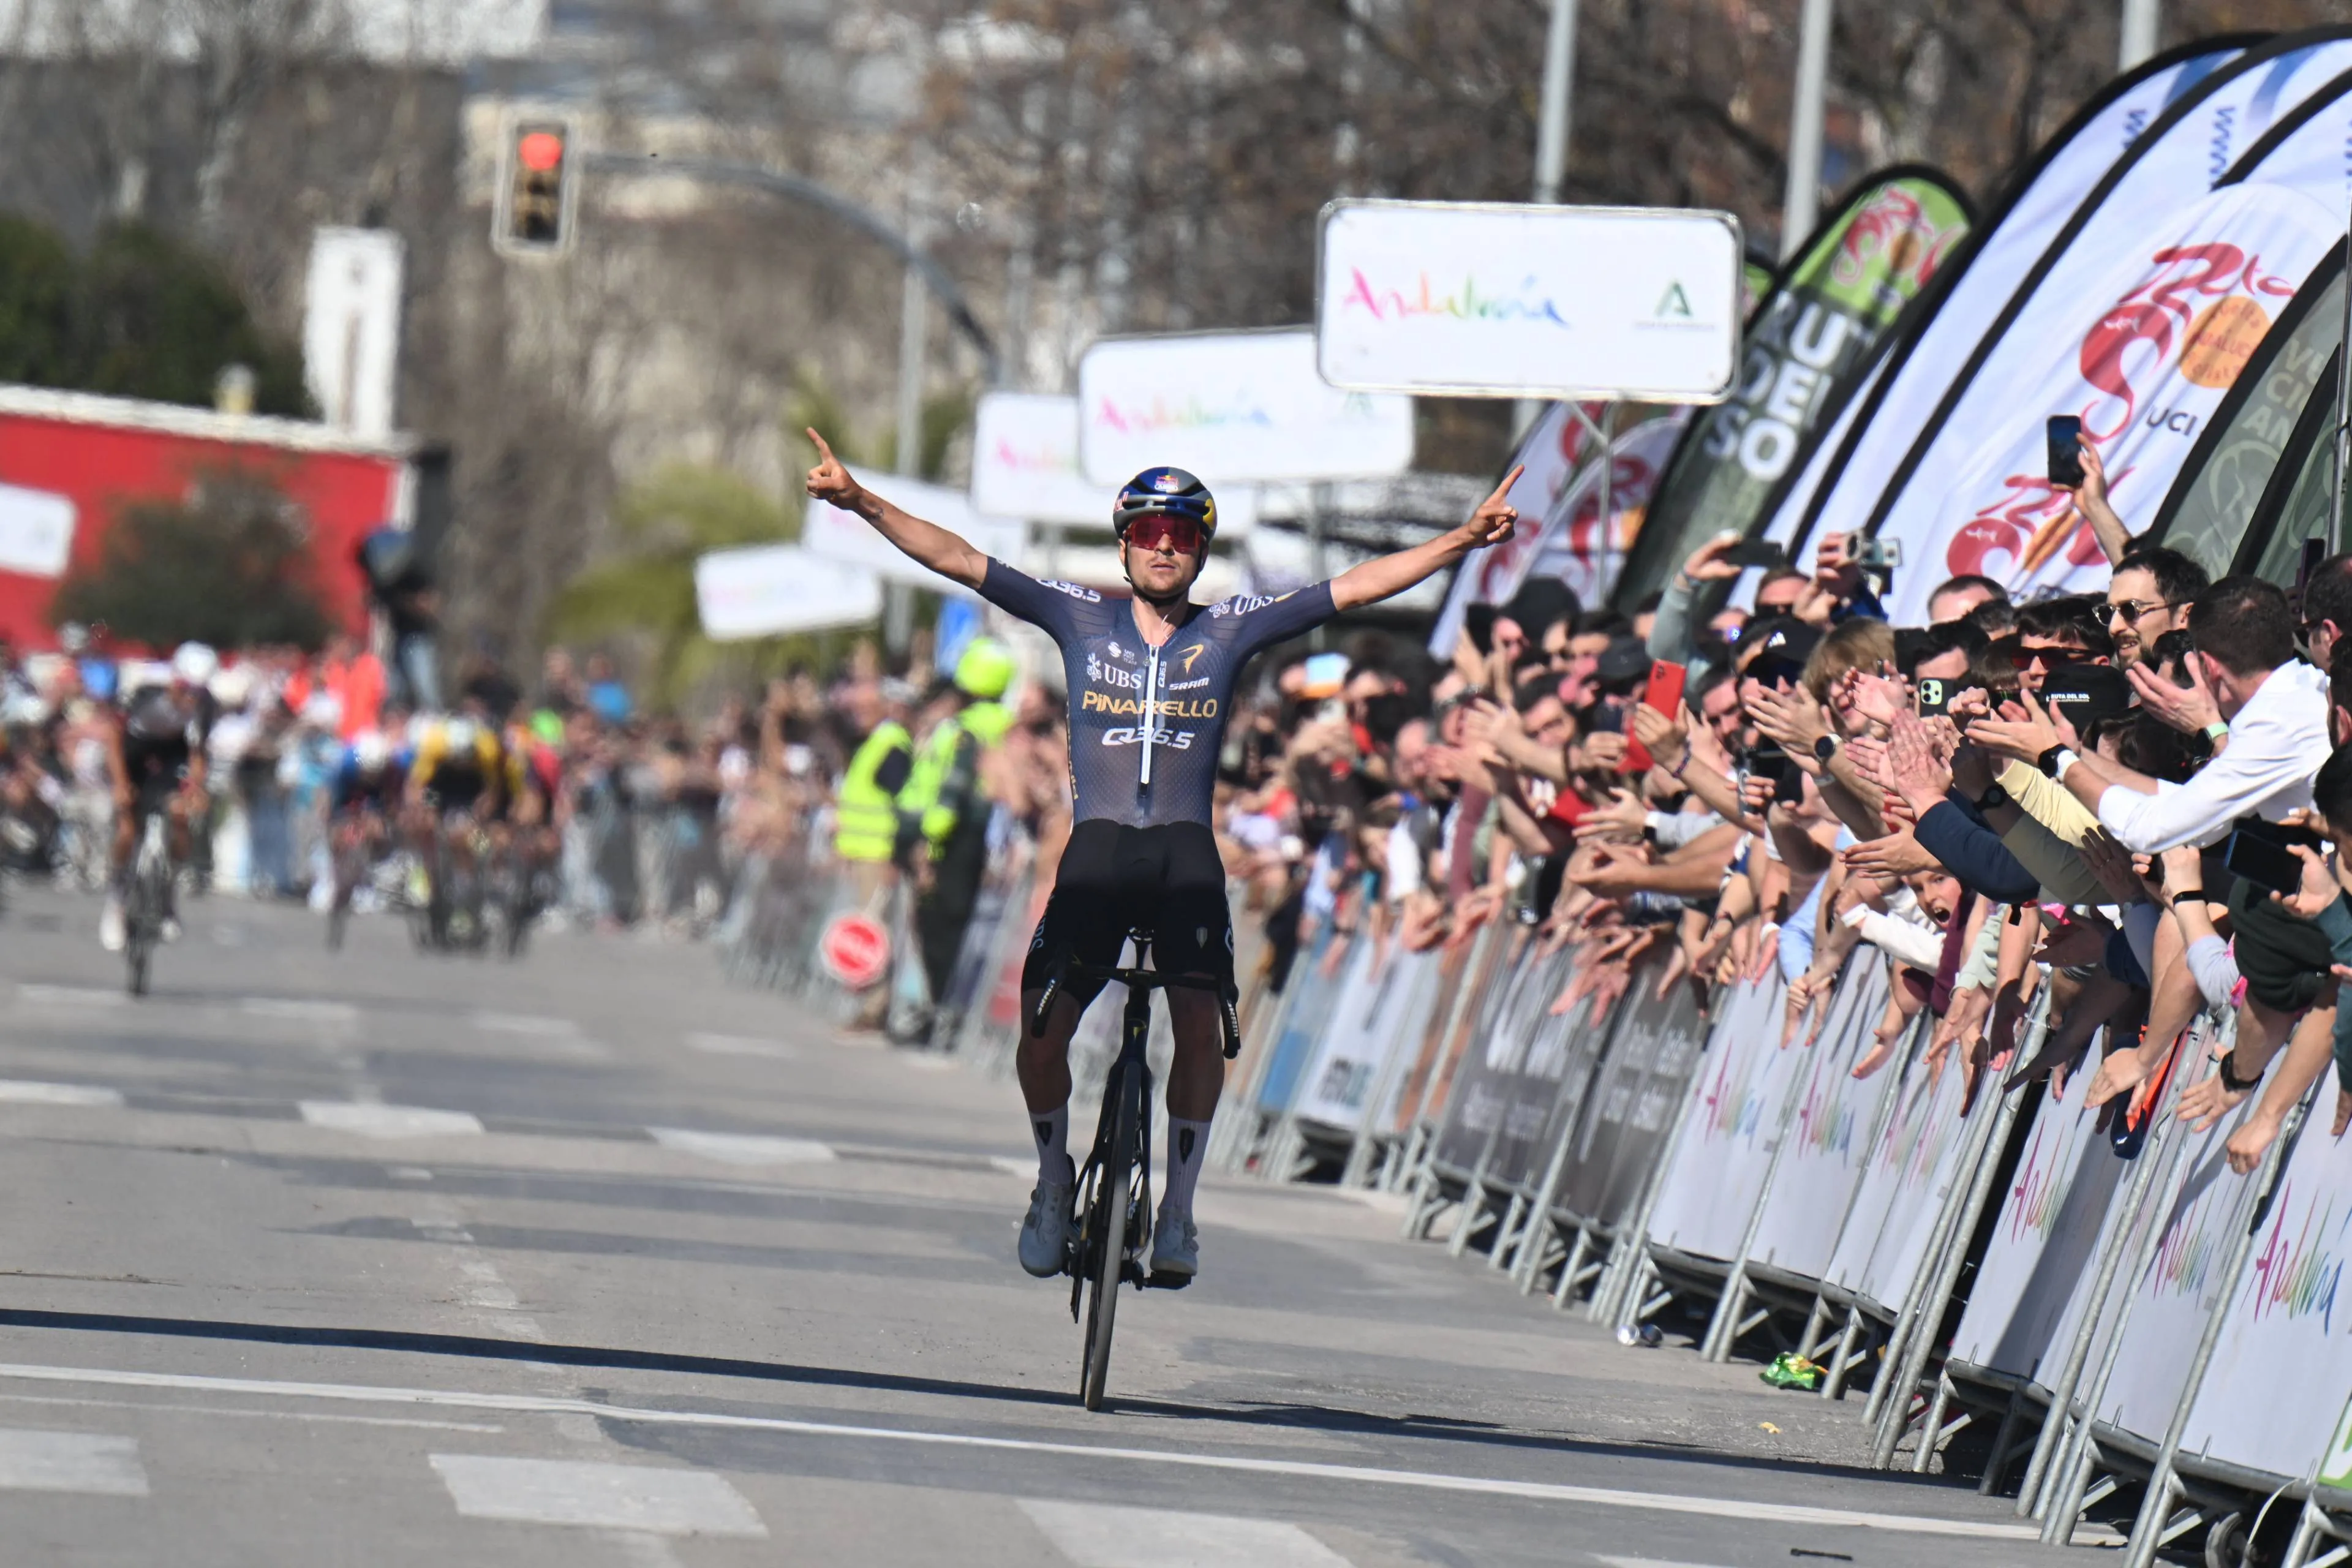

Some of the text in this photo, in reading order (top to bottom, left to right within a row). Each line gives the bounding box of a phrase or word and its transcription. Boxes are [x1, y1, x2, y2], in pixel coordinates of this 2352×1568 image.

[2146, 407, 2198, 437] UCI
[1035, 578, 1102, 603] Q36.5
[1234, 594, 1275, 616] UBS
[1104, 662, 1142, 689] UBS
[1168, 677, 1210, 690] SRAM
[1101, 726, 1196, 750] Q36.5
